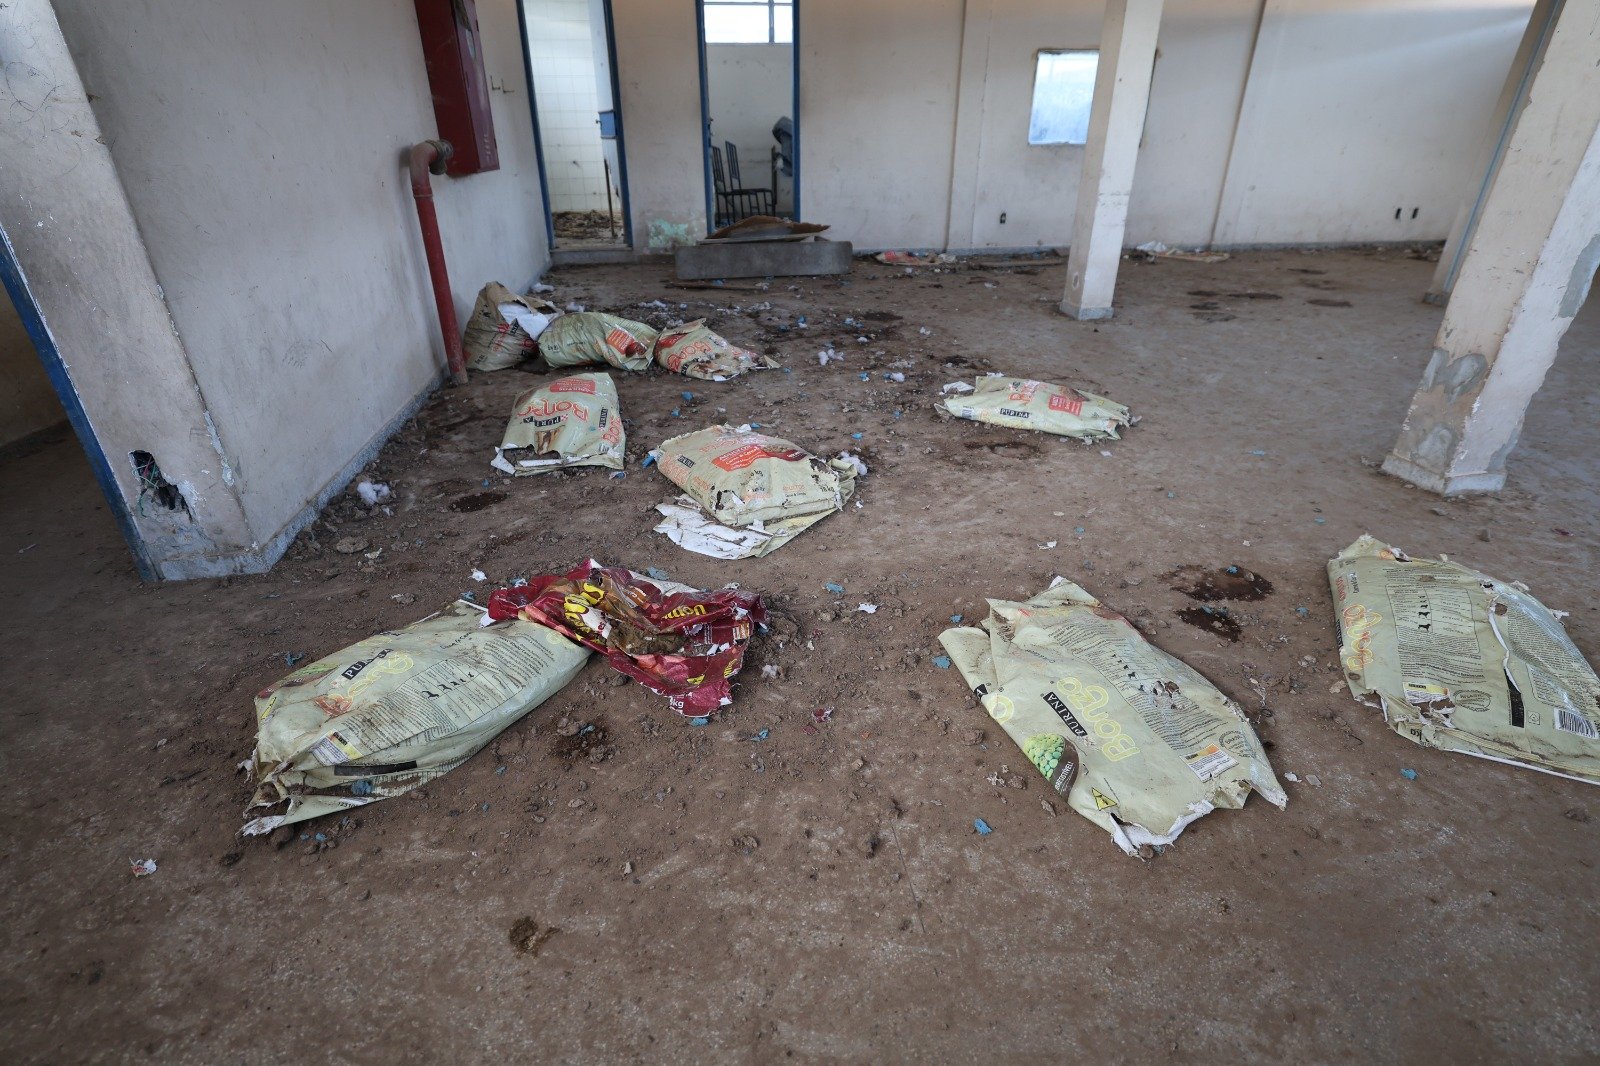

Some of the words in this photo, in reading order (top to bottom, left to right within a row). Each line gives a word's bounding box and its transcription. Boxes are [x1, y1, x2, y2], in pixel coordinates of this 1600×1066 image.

[1001, 408, 1029, 418] PURINA
[1046, 693, 1087, 736] PURINA
[1056, 677, 1140, 761] Bonzo
